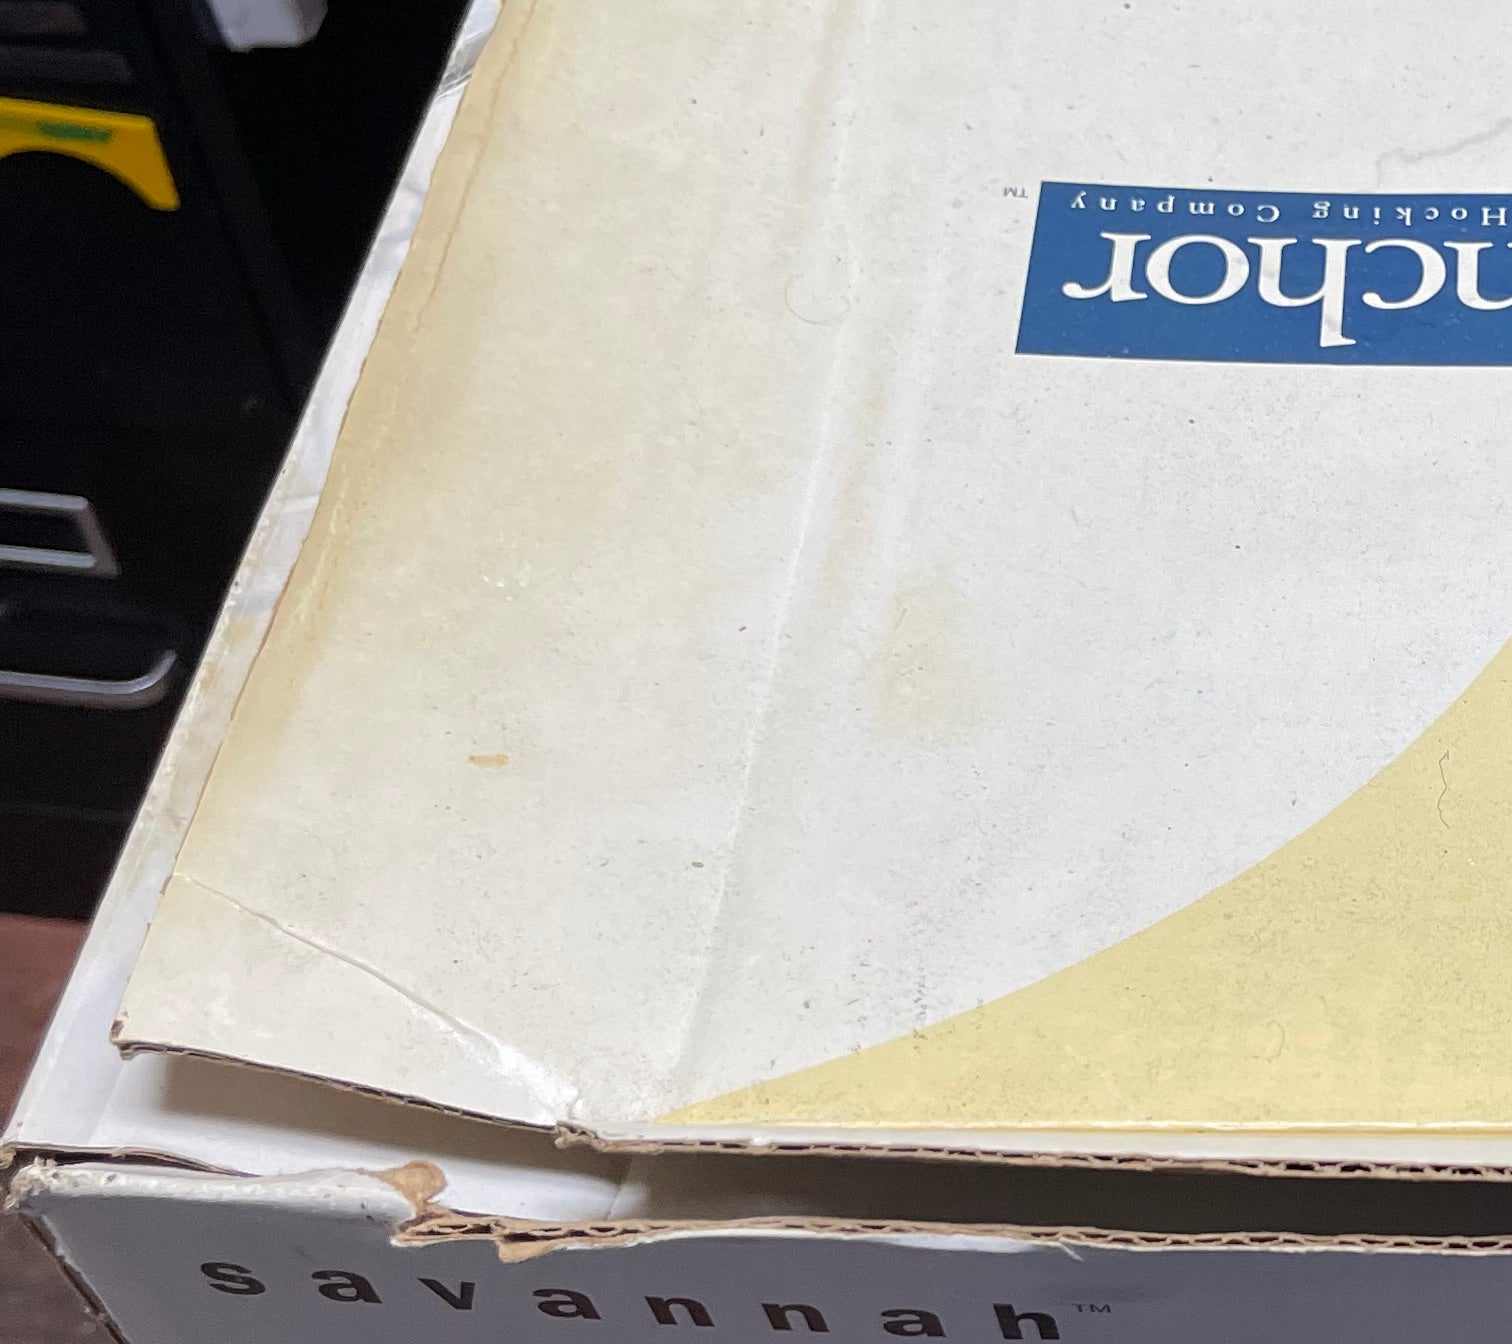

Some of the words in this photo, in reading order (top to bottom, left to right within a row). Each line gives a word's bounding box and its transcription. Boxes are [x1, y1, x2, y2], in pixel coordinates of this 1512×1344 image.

[1070, 191, 1281, 224] Company
[1312, 200, 1508, 227] Hocking
[200, 1259, 1061, 1342] savannah
